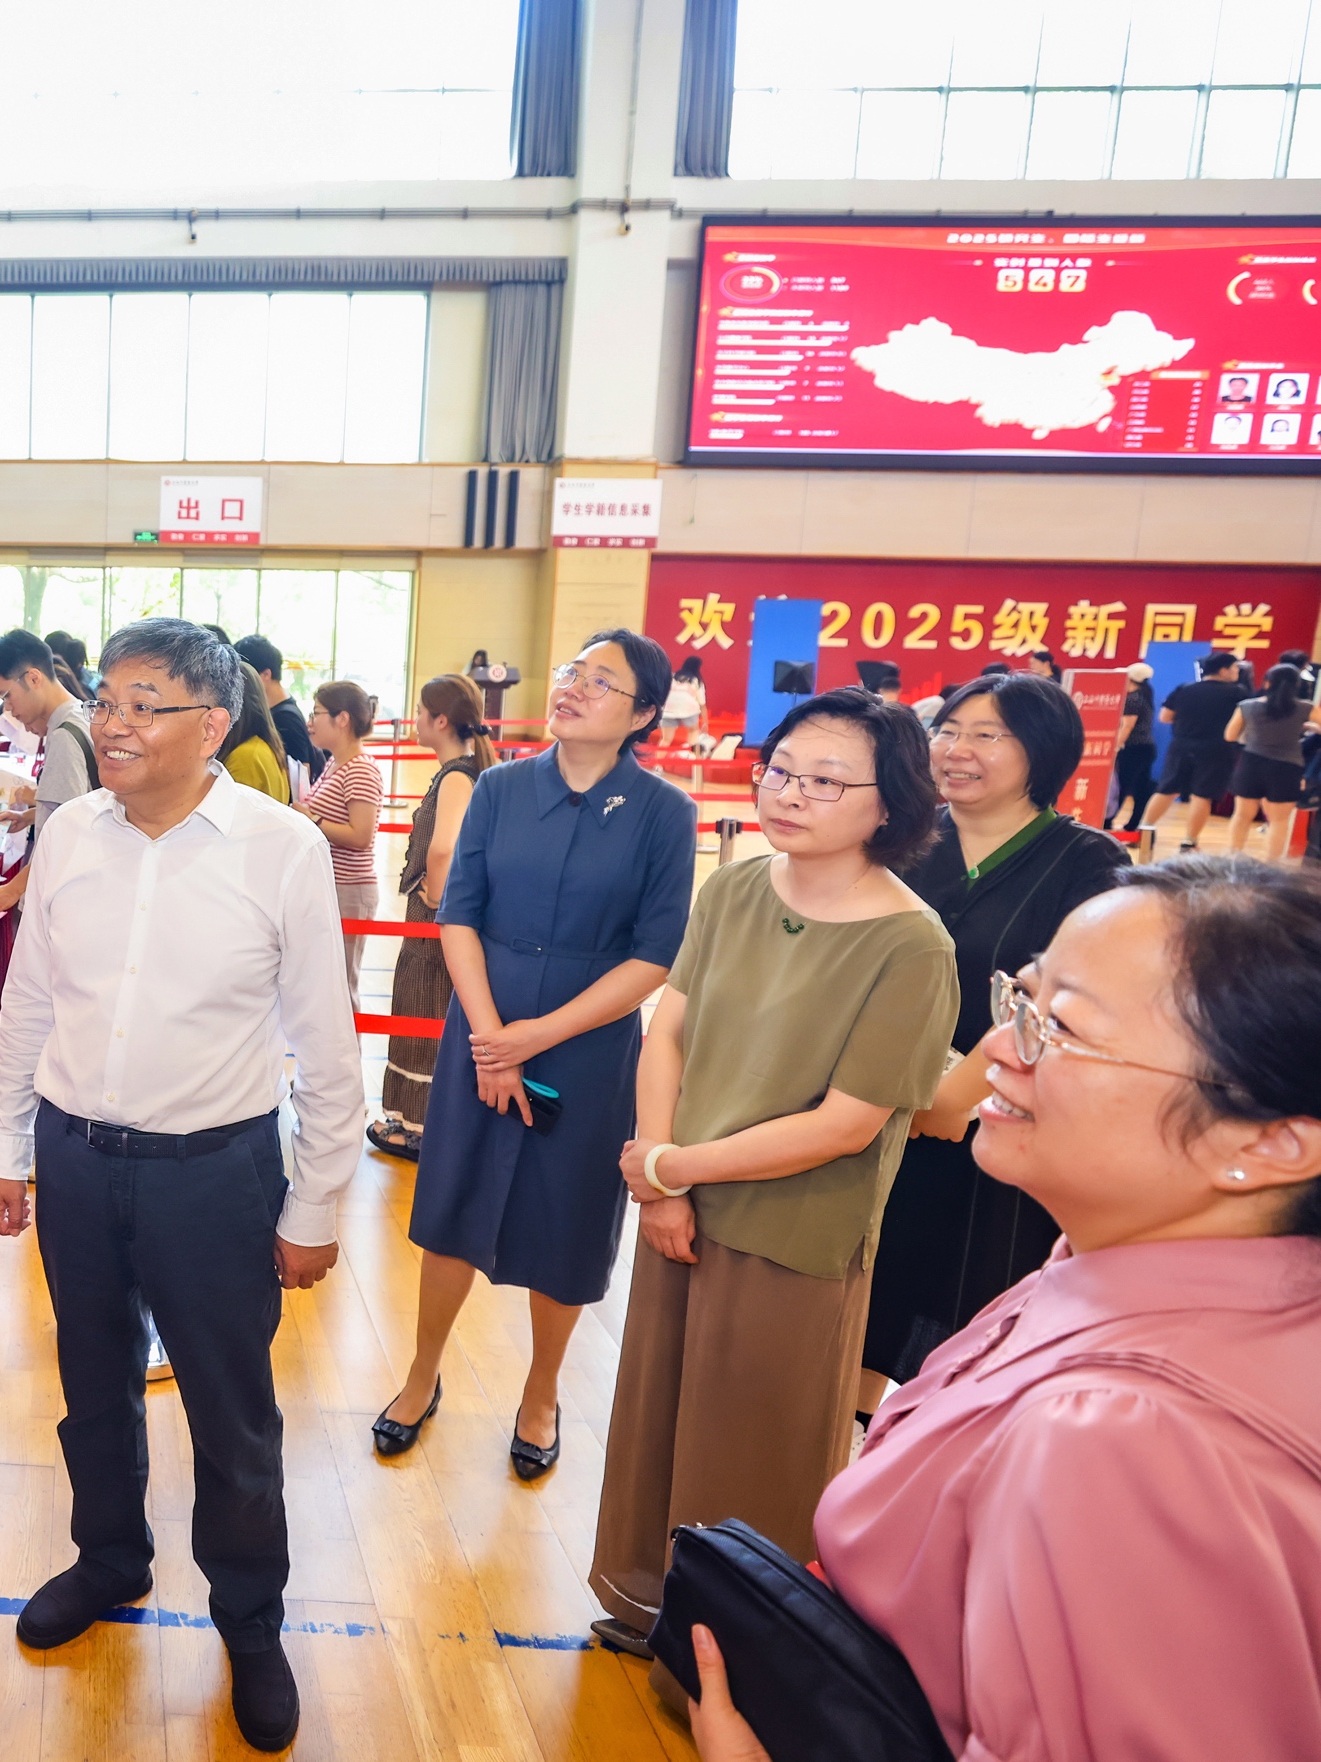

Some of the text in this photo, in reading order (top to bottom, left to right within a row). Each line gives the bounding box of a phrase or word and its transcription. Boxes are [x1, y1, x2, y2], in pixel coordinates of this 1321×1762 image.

[1002, 273, 1083, 290] 547
[177, 497, 244, 521] 出口
[676, 593, 1274, 660] 欢2025级新同学
